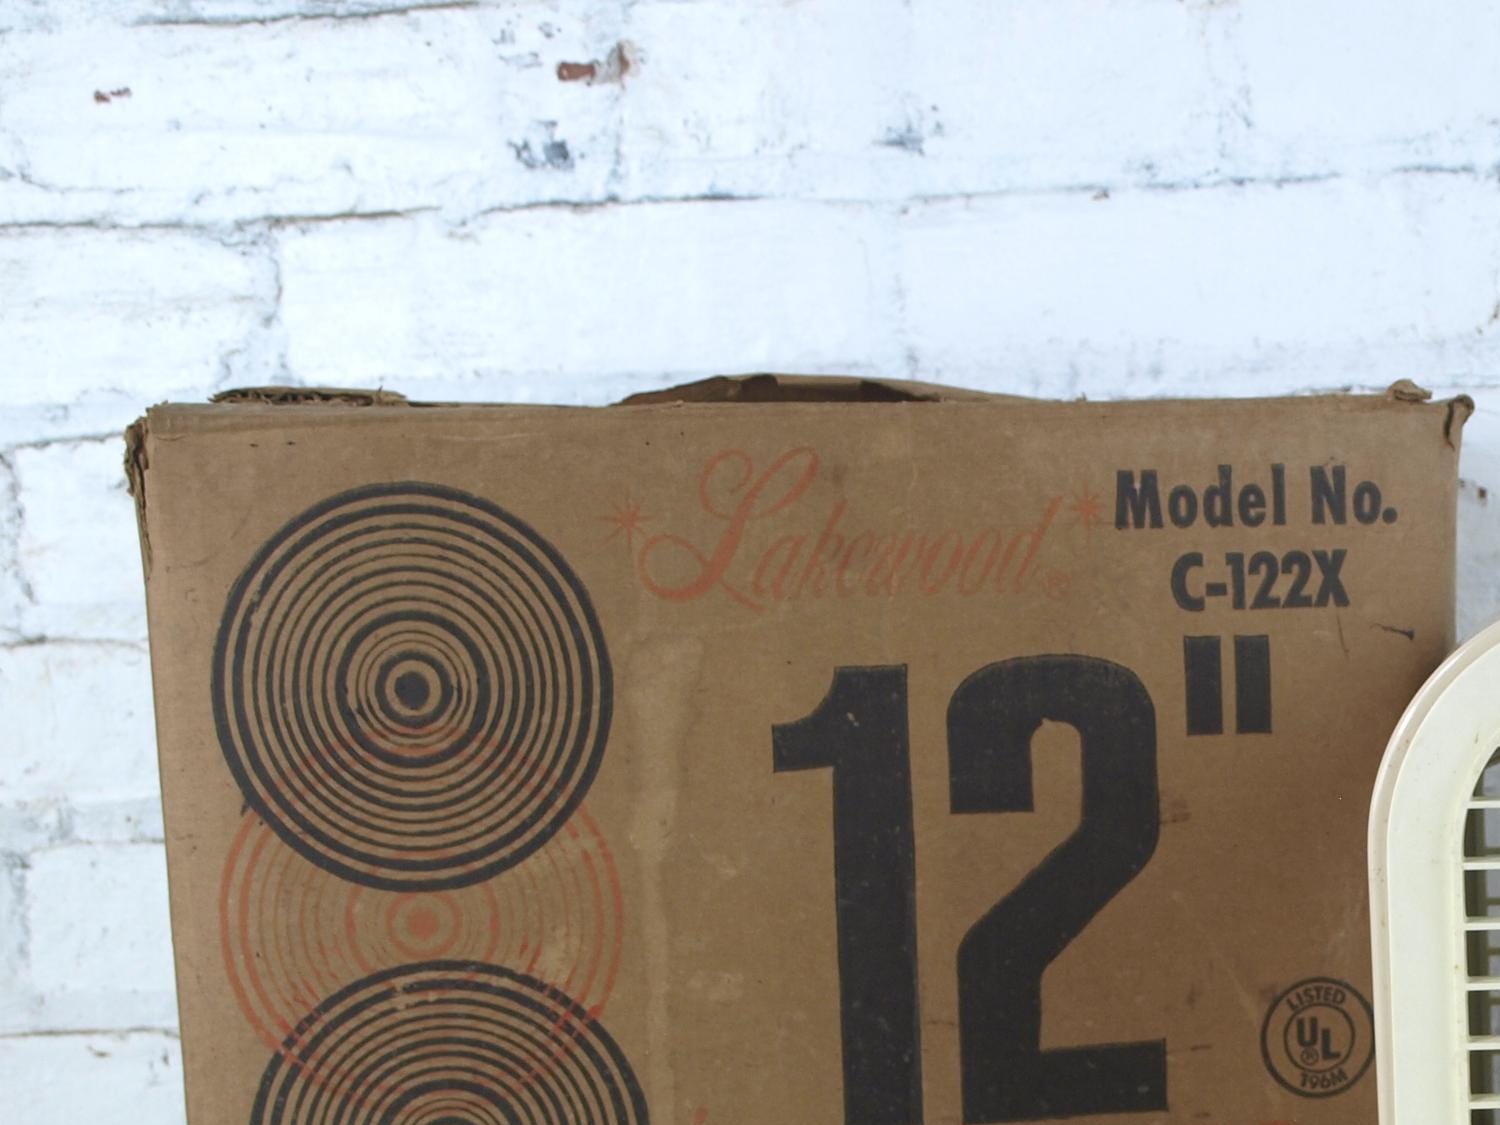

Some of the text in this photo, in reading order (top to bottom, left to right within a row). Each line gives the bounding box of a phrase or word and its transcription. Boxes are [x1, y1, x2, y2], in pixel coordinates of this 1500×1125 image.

[1114, 464, 1398, 530] Model No.
[1169, 548, 1350, 612] C-122X
[1286, 986, 1347, 1012] LISTED
[1297, 1017, 1341, 1060] UL
